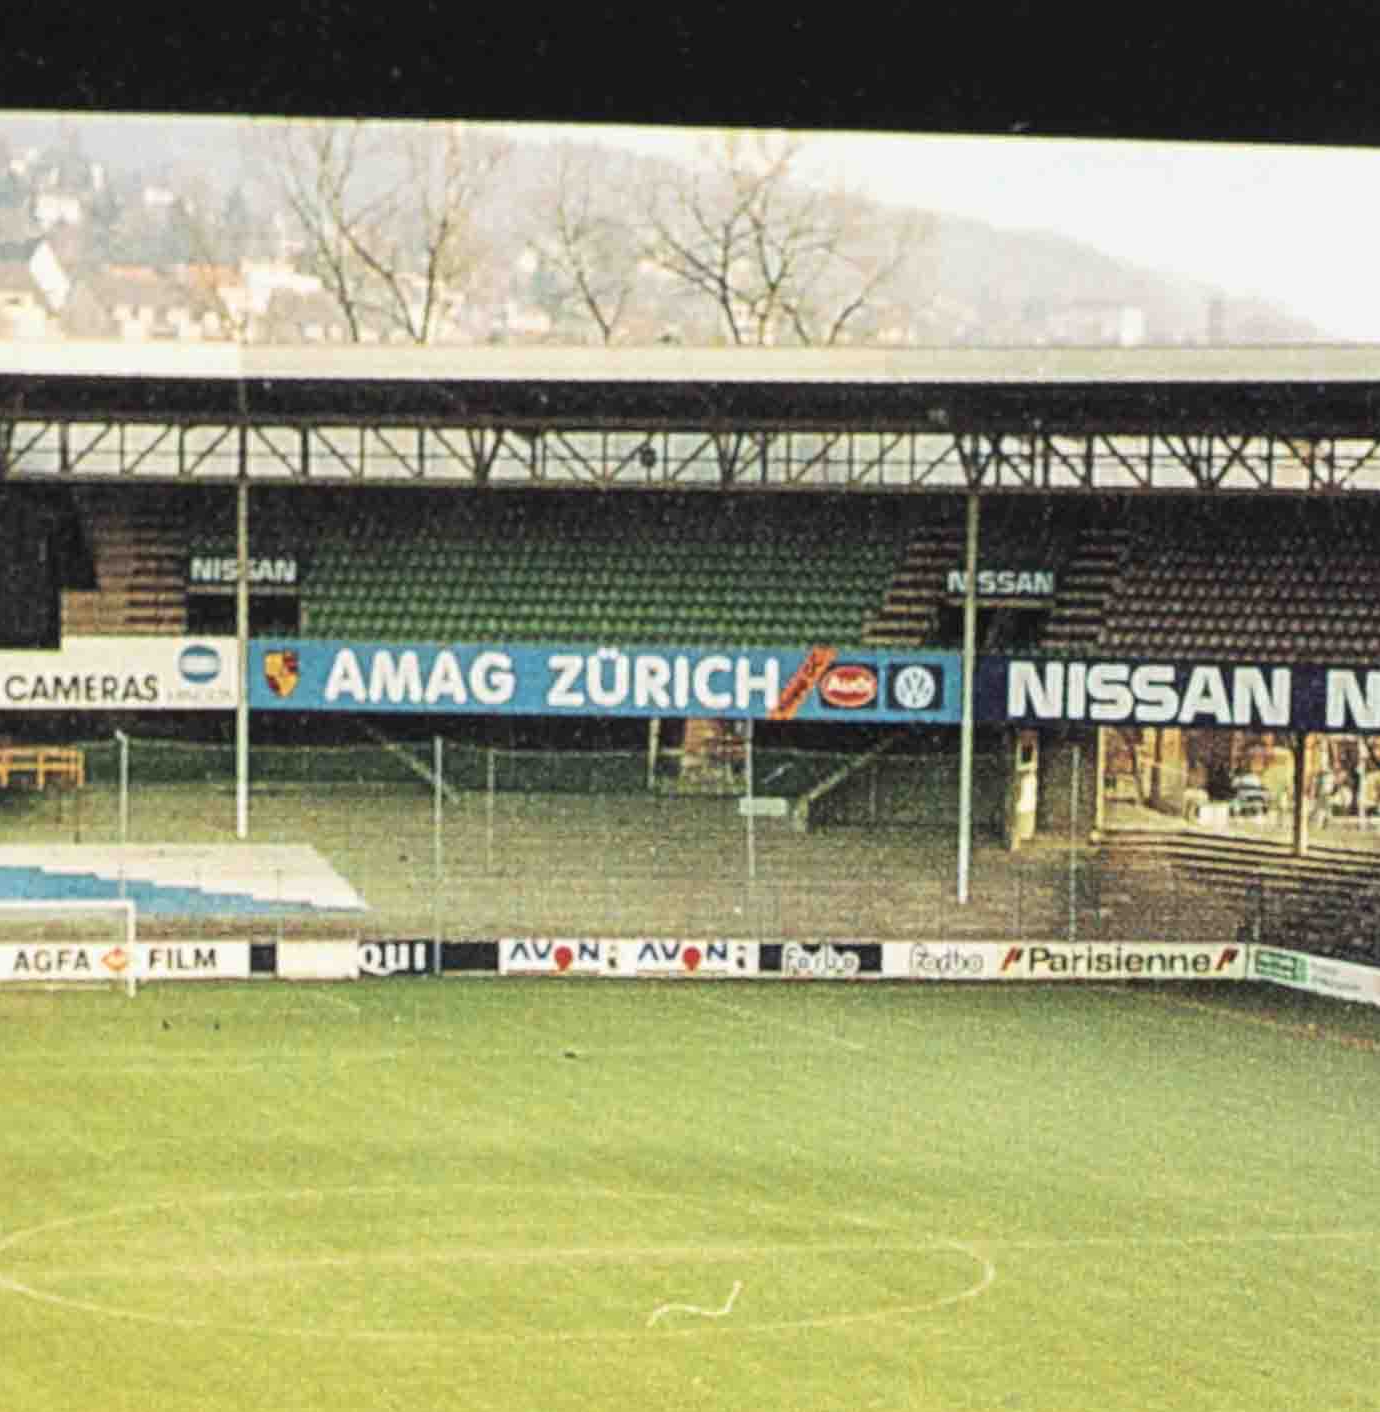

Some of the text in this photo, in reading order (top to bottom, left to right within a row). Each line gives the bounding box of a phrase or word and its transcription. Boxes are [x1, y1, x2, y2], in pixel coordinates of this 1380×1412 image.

[947, 569, 1054, 595] NSSAN
[4, 674, 159, 702] CAMERAS
[323, 649, 517, 707] AMAG
[546, 648, 781, 711] ZÜRICH
[1007, 660, 1292, 725] NISSAN
[13, 946, 218, 971] AGFA FILM
[1028, 945, 1212, 974] Parisienne
